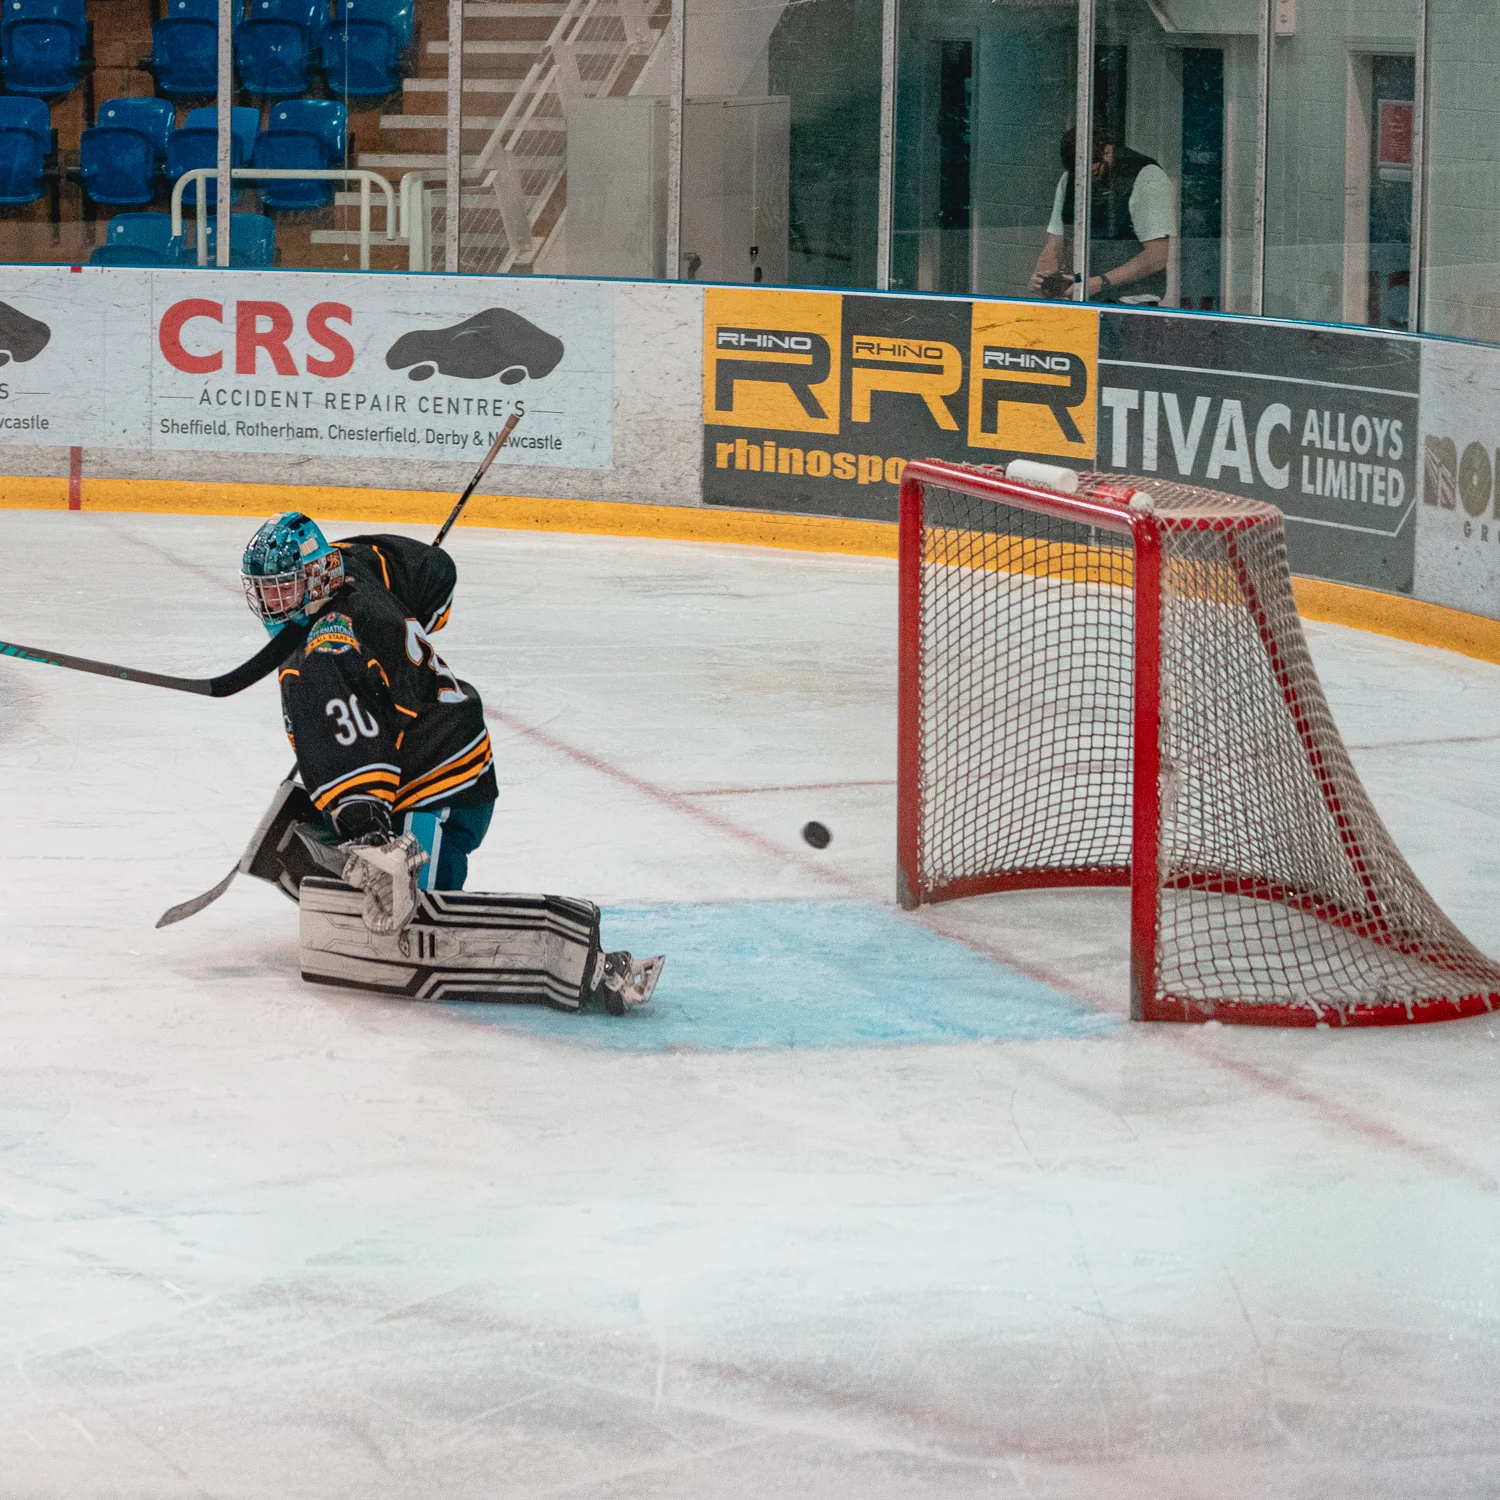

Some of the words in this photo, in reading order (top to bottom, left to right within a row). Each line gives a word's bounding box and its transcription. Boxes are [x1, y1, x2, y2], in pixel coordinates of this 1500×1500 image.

[159, 298, 354, 378] CRS
[717, 331, 812, 351] RHINO
[855, 340, 944, 360] RHINO
[984, 350, 1071, 372] RHINO
[199, 388, 313, 409] ACCIDENT
[324, 392, 407, 413] REPAIR
[160, 418, 231, 437] Sheffield,
[236, 421, 324, 440] Rotherham,
[328, 424, 421, 445] Chesterfield,
[425, 428, 469, 449] Derby
[472, 431, 484, 447] &
[1102, 386, 1292, 490] TIVAC
[1301, 408, 1403, 461] ALLOYS
[1301, 454, 1406, 507] LIMITED
[325, 693, 380, 747] 30
